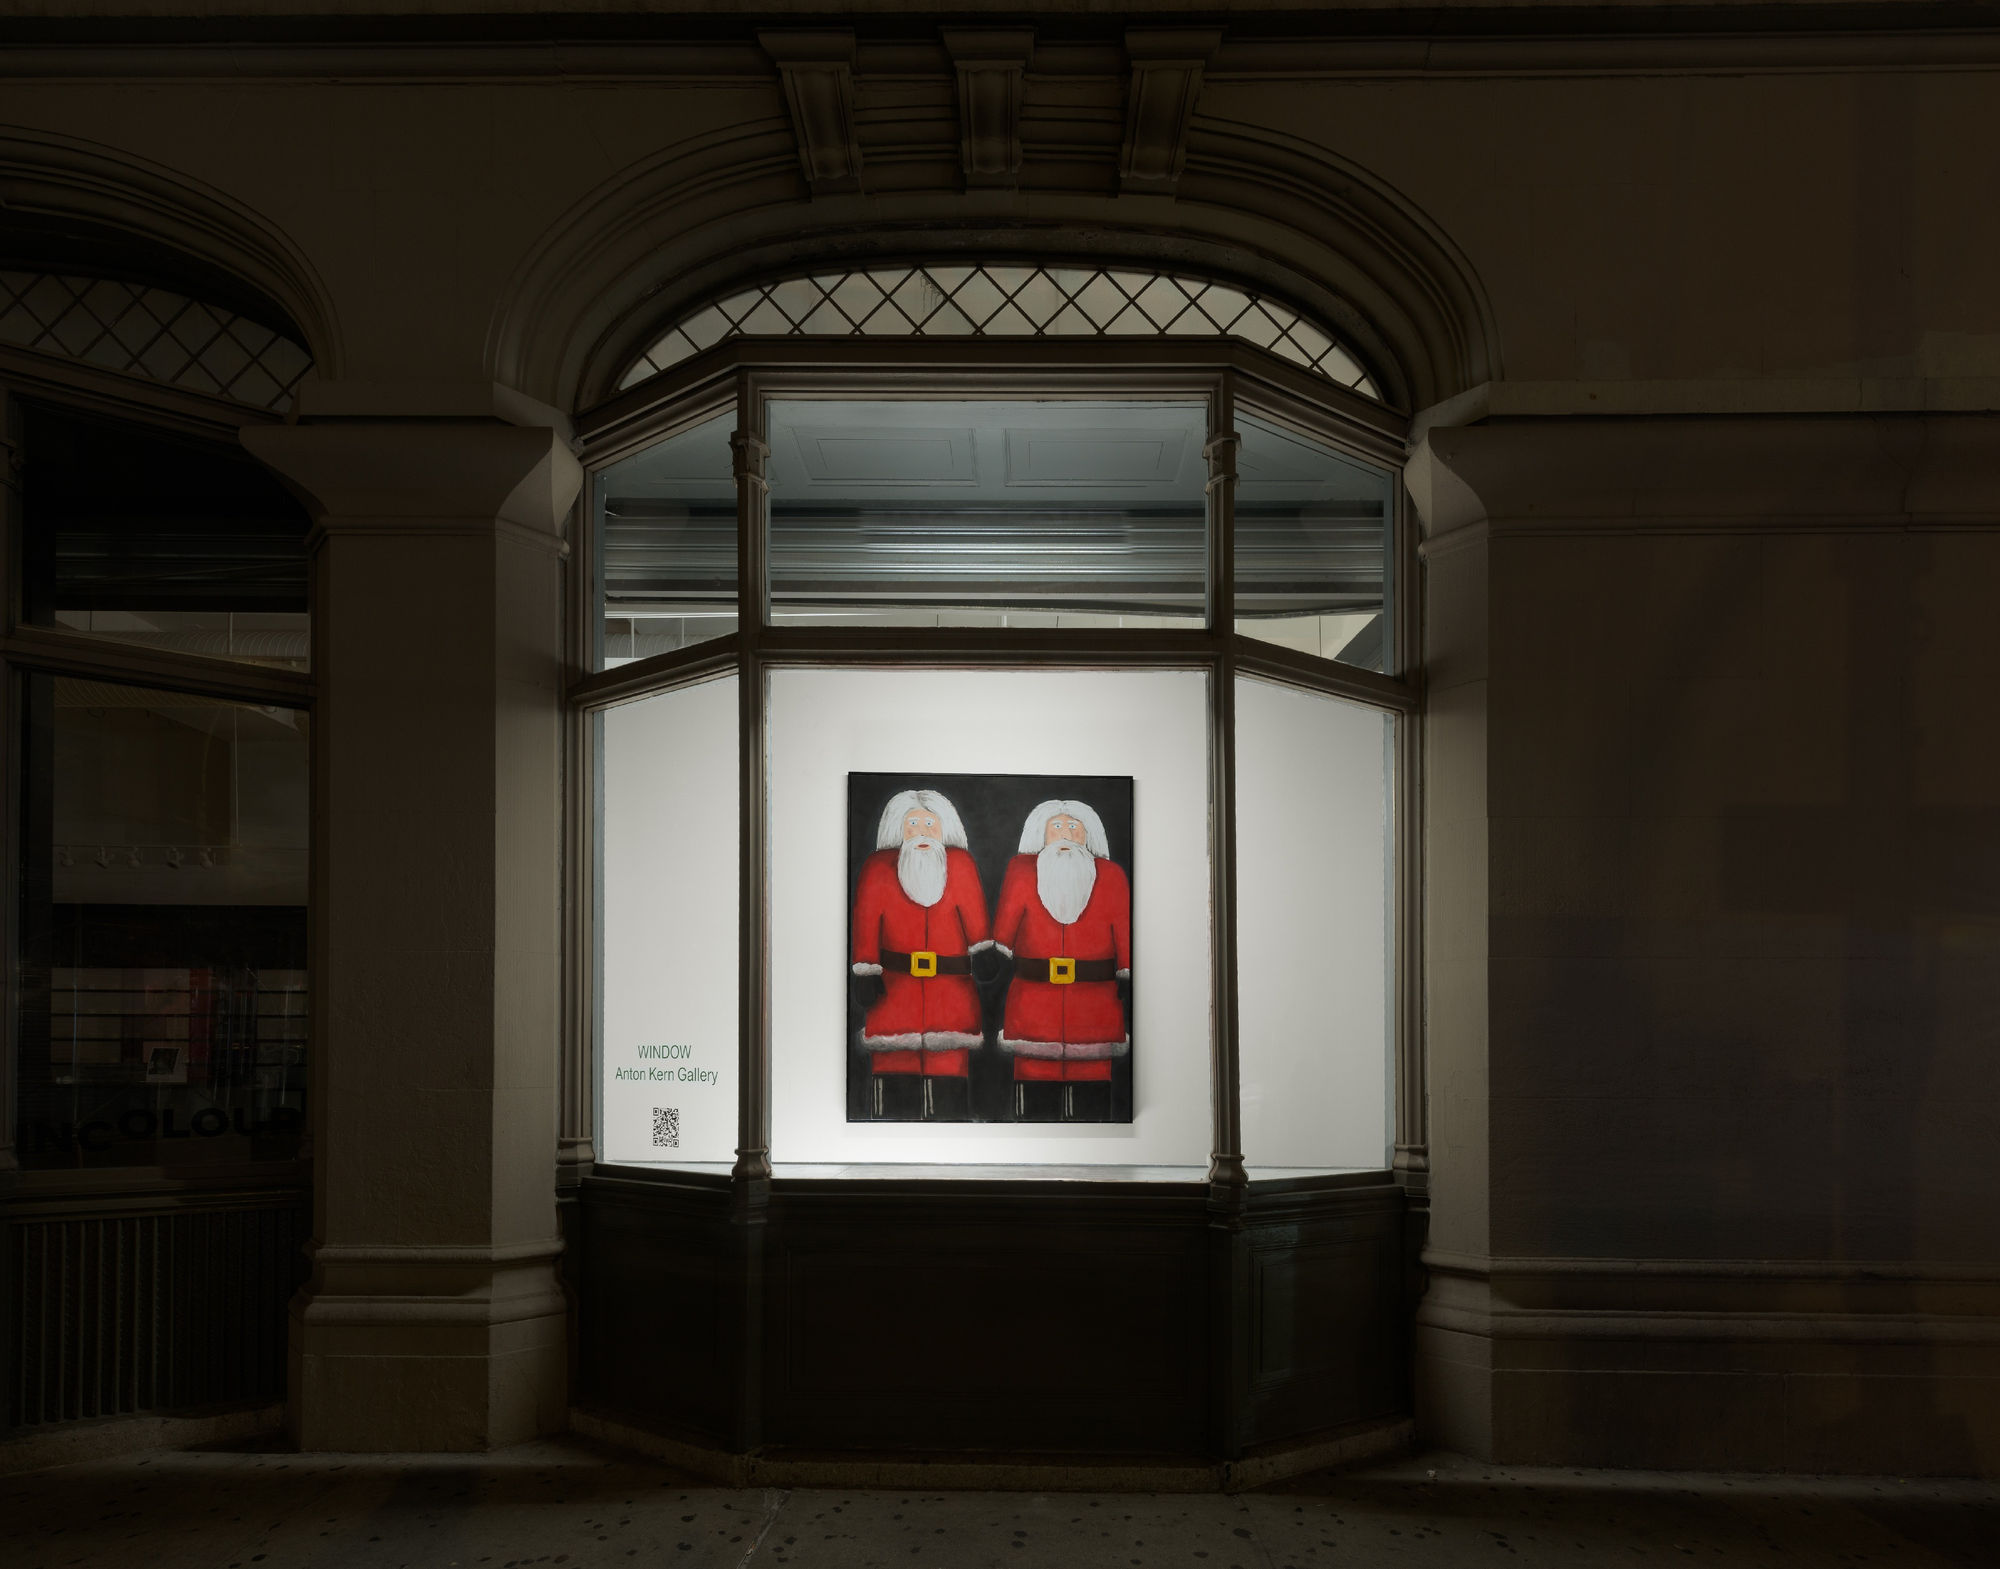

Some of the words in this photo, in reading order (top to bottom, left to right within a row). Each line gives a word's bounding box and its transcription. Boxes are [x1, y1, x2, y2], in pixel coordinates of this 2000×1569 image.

[638, 1044, 692, 1059] WINDOW
[615, 1066, 646, 1081] Anton
[649, 1067, 675, 1082] Kern
[677, 1066, 719, 1086] Gallery
